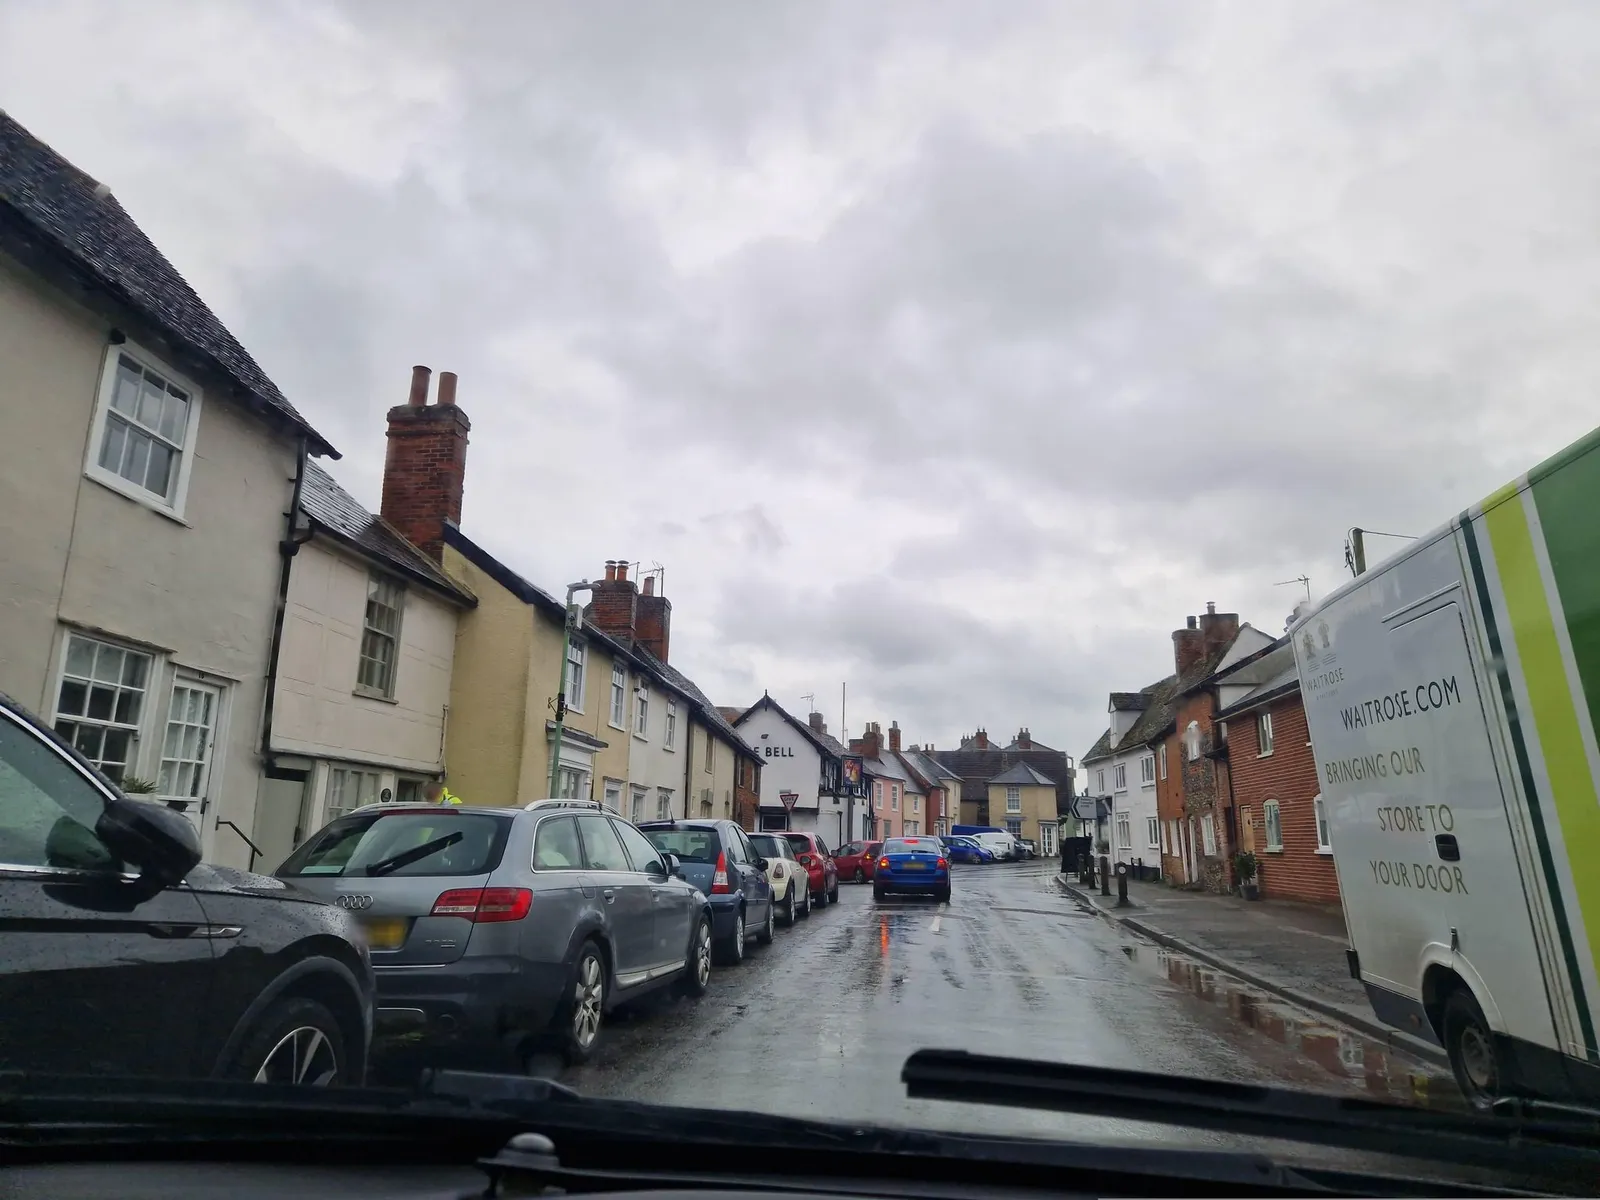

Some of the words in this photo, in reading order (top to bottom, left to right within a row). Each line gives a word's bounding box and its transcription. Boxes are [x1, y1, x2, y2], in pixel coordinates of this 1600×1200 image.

[1305, 667, 1344, 692] WAITROSE
[1340, 675, 1461, 731] WAITROSE.COM
[765, 746, 794, 757] BELL
[1325, 753, 1387, 784] BRINGING
[1390, 747, 1425, 774] OUR
[1377, 806, 1425, 832] STORE
[1425, 804, 1454, 832] TO
[1369, 860, 1412, 888] YOUR
[1413, 863, 1469, 895] DOOR
